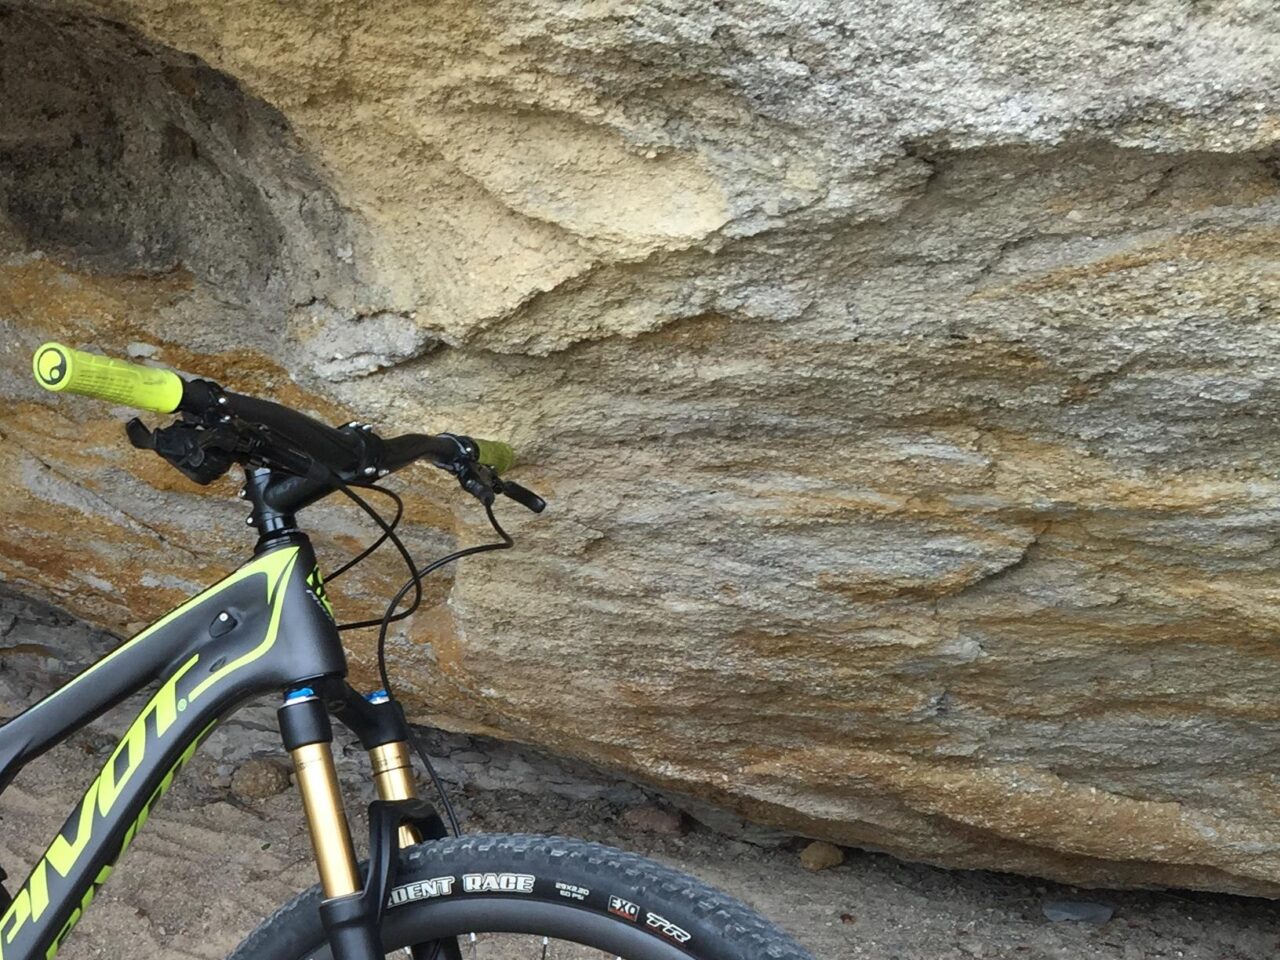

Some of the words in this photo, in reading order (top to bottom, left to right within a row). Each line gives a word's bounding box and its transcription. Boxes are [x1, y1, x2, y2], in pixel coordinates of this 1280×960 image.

[387, 876, 454, 908] DENT
[462, 873, 535, 893] RACE
[608, 895, 639, 918] EXO
[646, 912, 691, 943] TR
